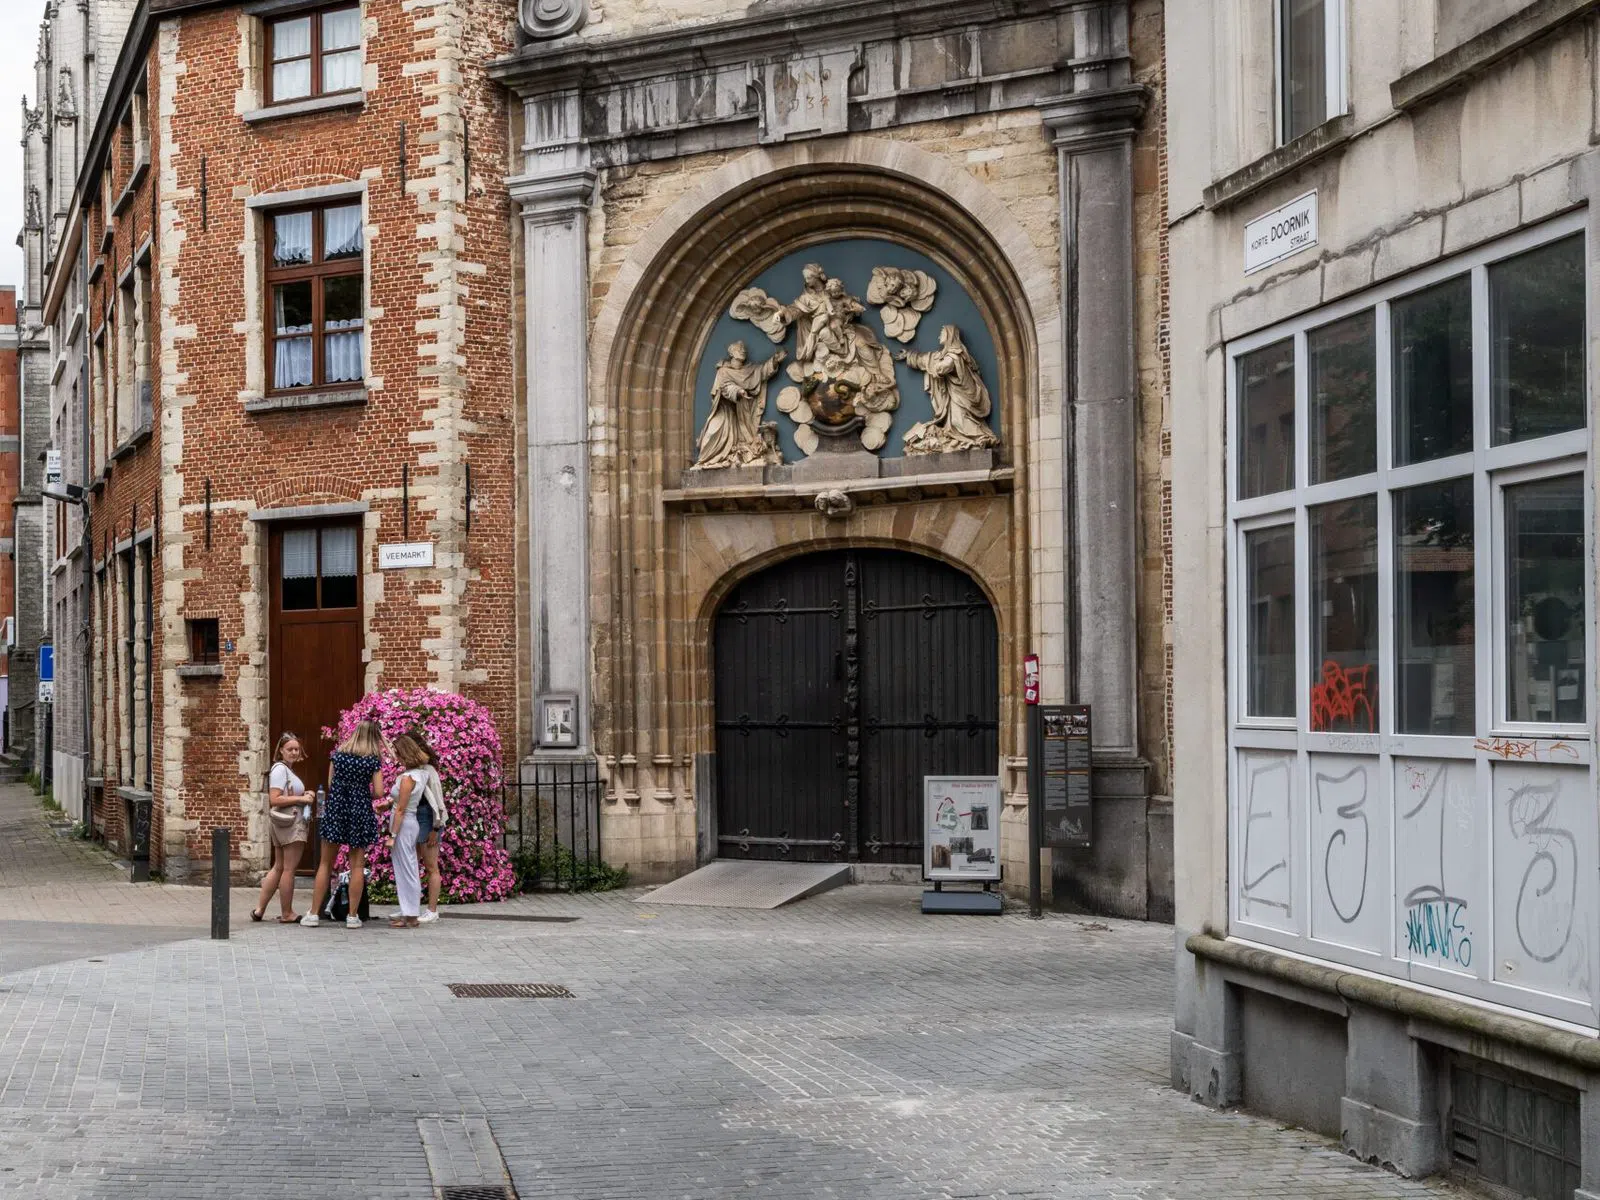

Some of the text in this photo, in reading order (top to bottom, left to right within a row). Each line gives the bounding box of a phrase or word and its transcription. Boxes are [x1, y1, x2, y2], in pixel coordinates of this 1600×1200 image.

[1251, 209, 1310, 251] KORTE DOORNIK
[1290, 230, 1310, 248] STRAAT
[385, 550, 426, 560] VEEMARKT
